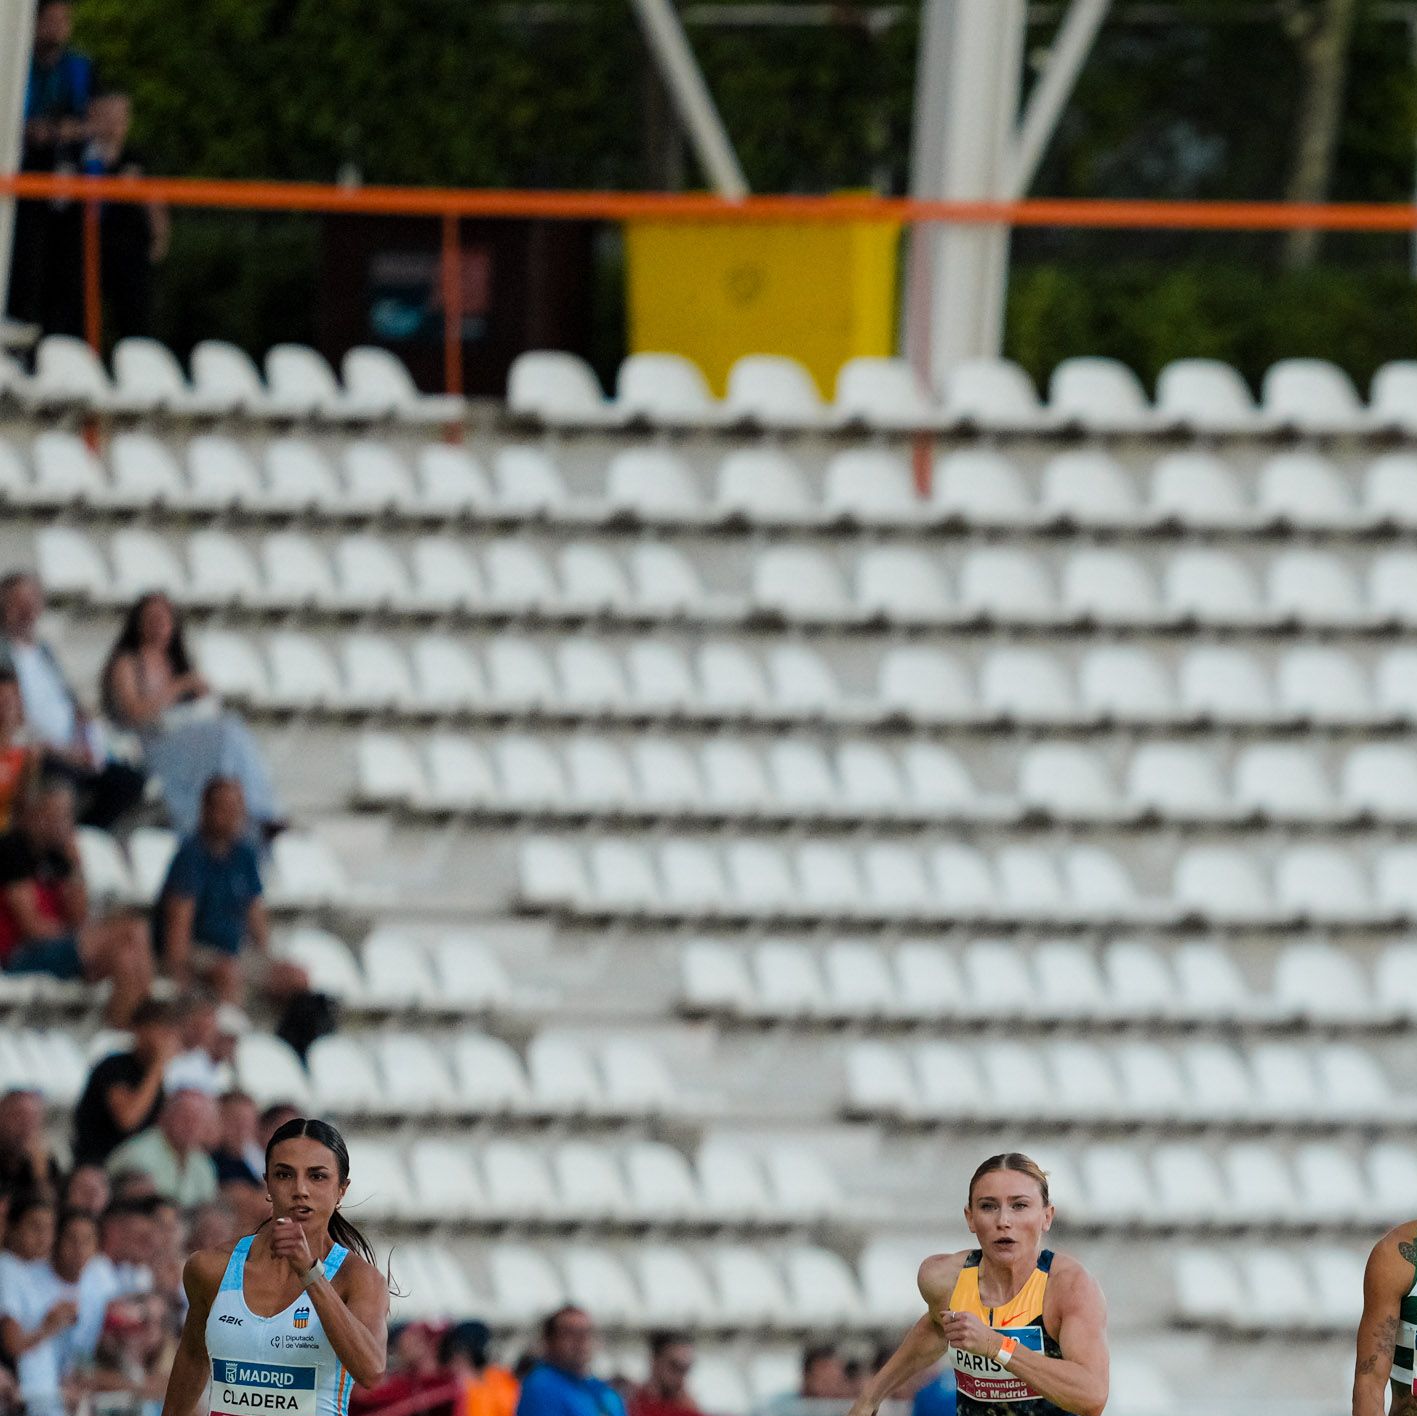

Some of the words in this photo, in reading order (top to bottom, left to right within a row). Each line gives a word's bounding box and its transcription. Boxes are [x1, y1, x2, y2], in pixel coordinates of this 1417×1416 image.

[218, 1315, 244, 1326] 42K
[957, 1350, 1002, 1372] PARIS
[239, 1367, 295, 1388] MADRID
[222, 1389, 299, 1410] CLADERA
[975, 1389, 988, 1398] de
[989, 1387, 1029, 1399] Madrid
